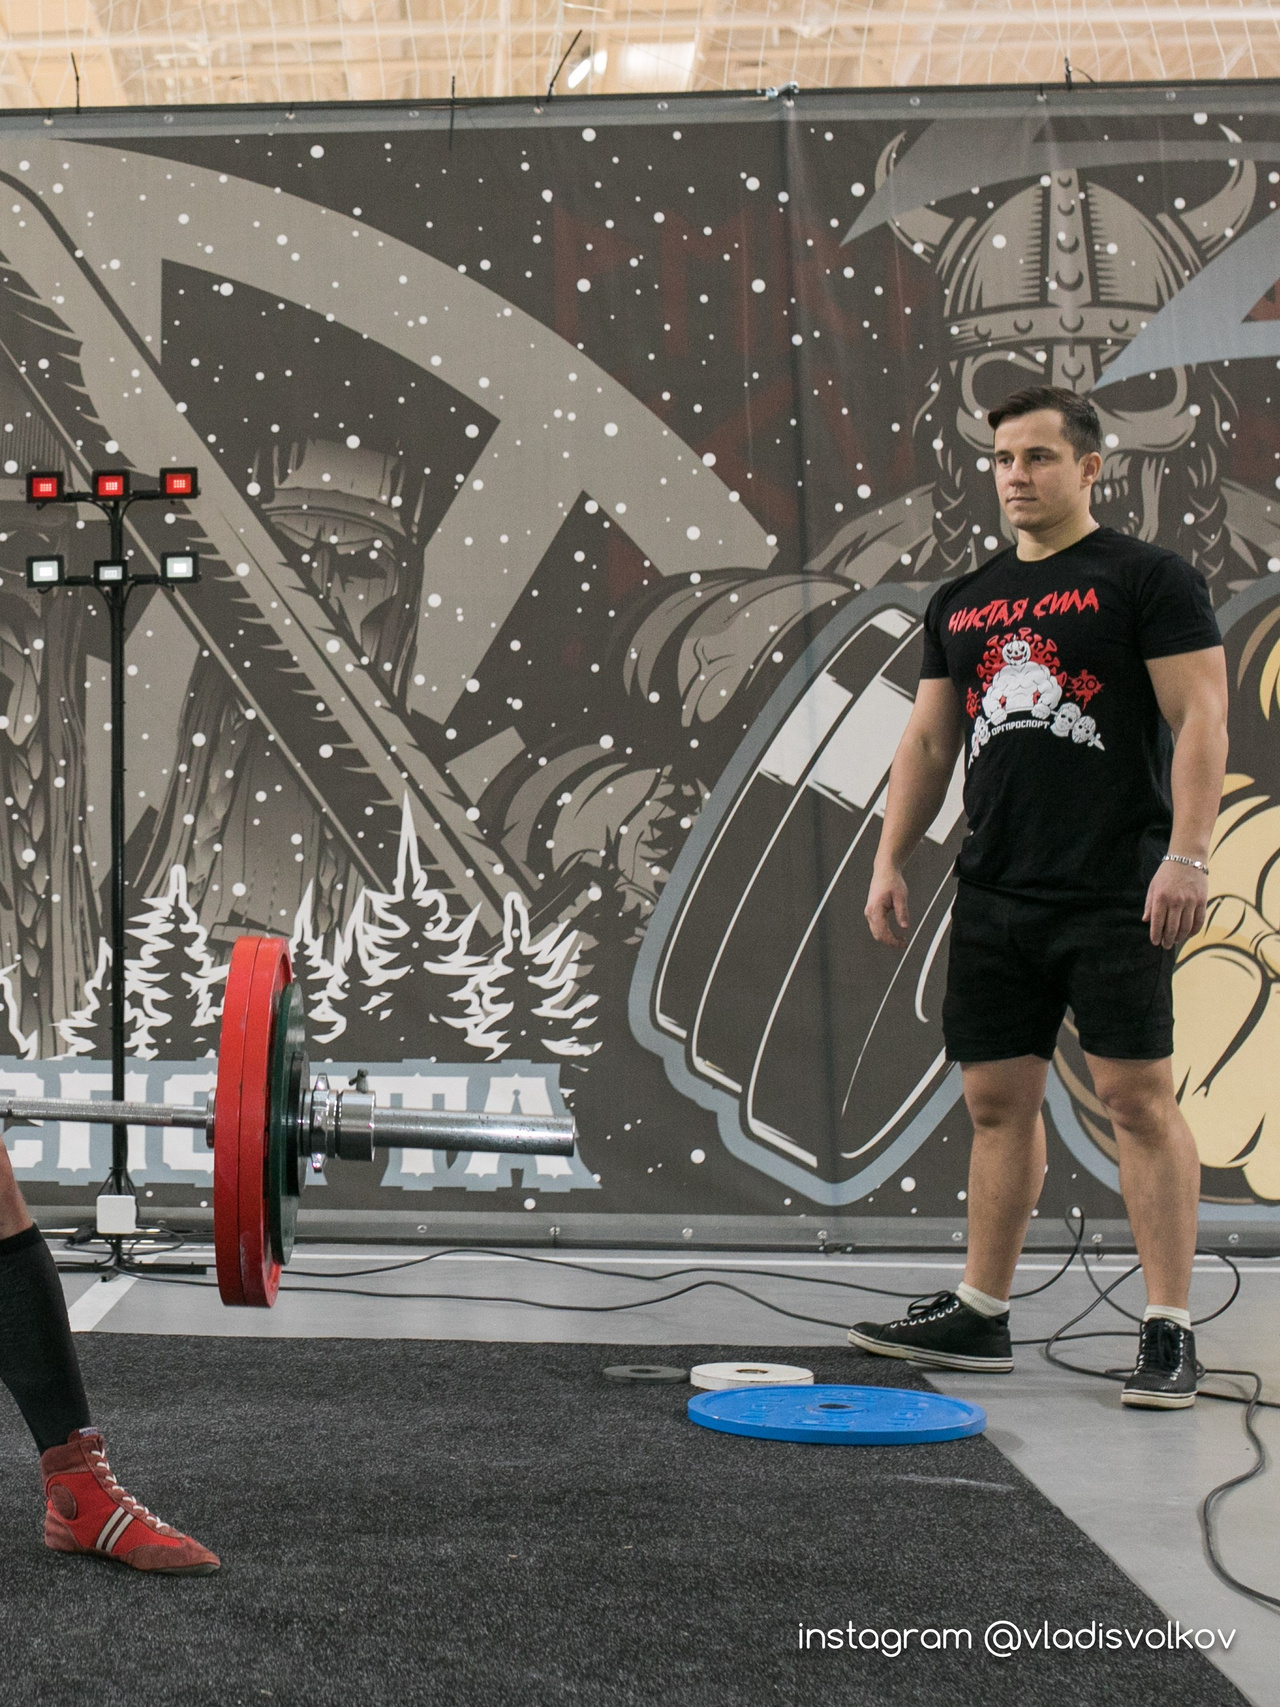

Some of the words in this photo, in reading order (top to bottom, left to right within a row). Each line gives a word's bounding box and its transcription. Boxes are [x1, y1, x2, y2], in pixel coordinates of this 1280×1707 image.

[948, 597, 1029, 636] ЧИСТАЯ
[1033, 587, 1100, 620] СИЛА
[1076, 677, 1098, 691] 20
[991, 719, 1051, 737] ОРГПРОСПОРТ
